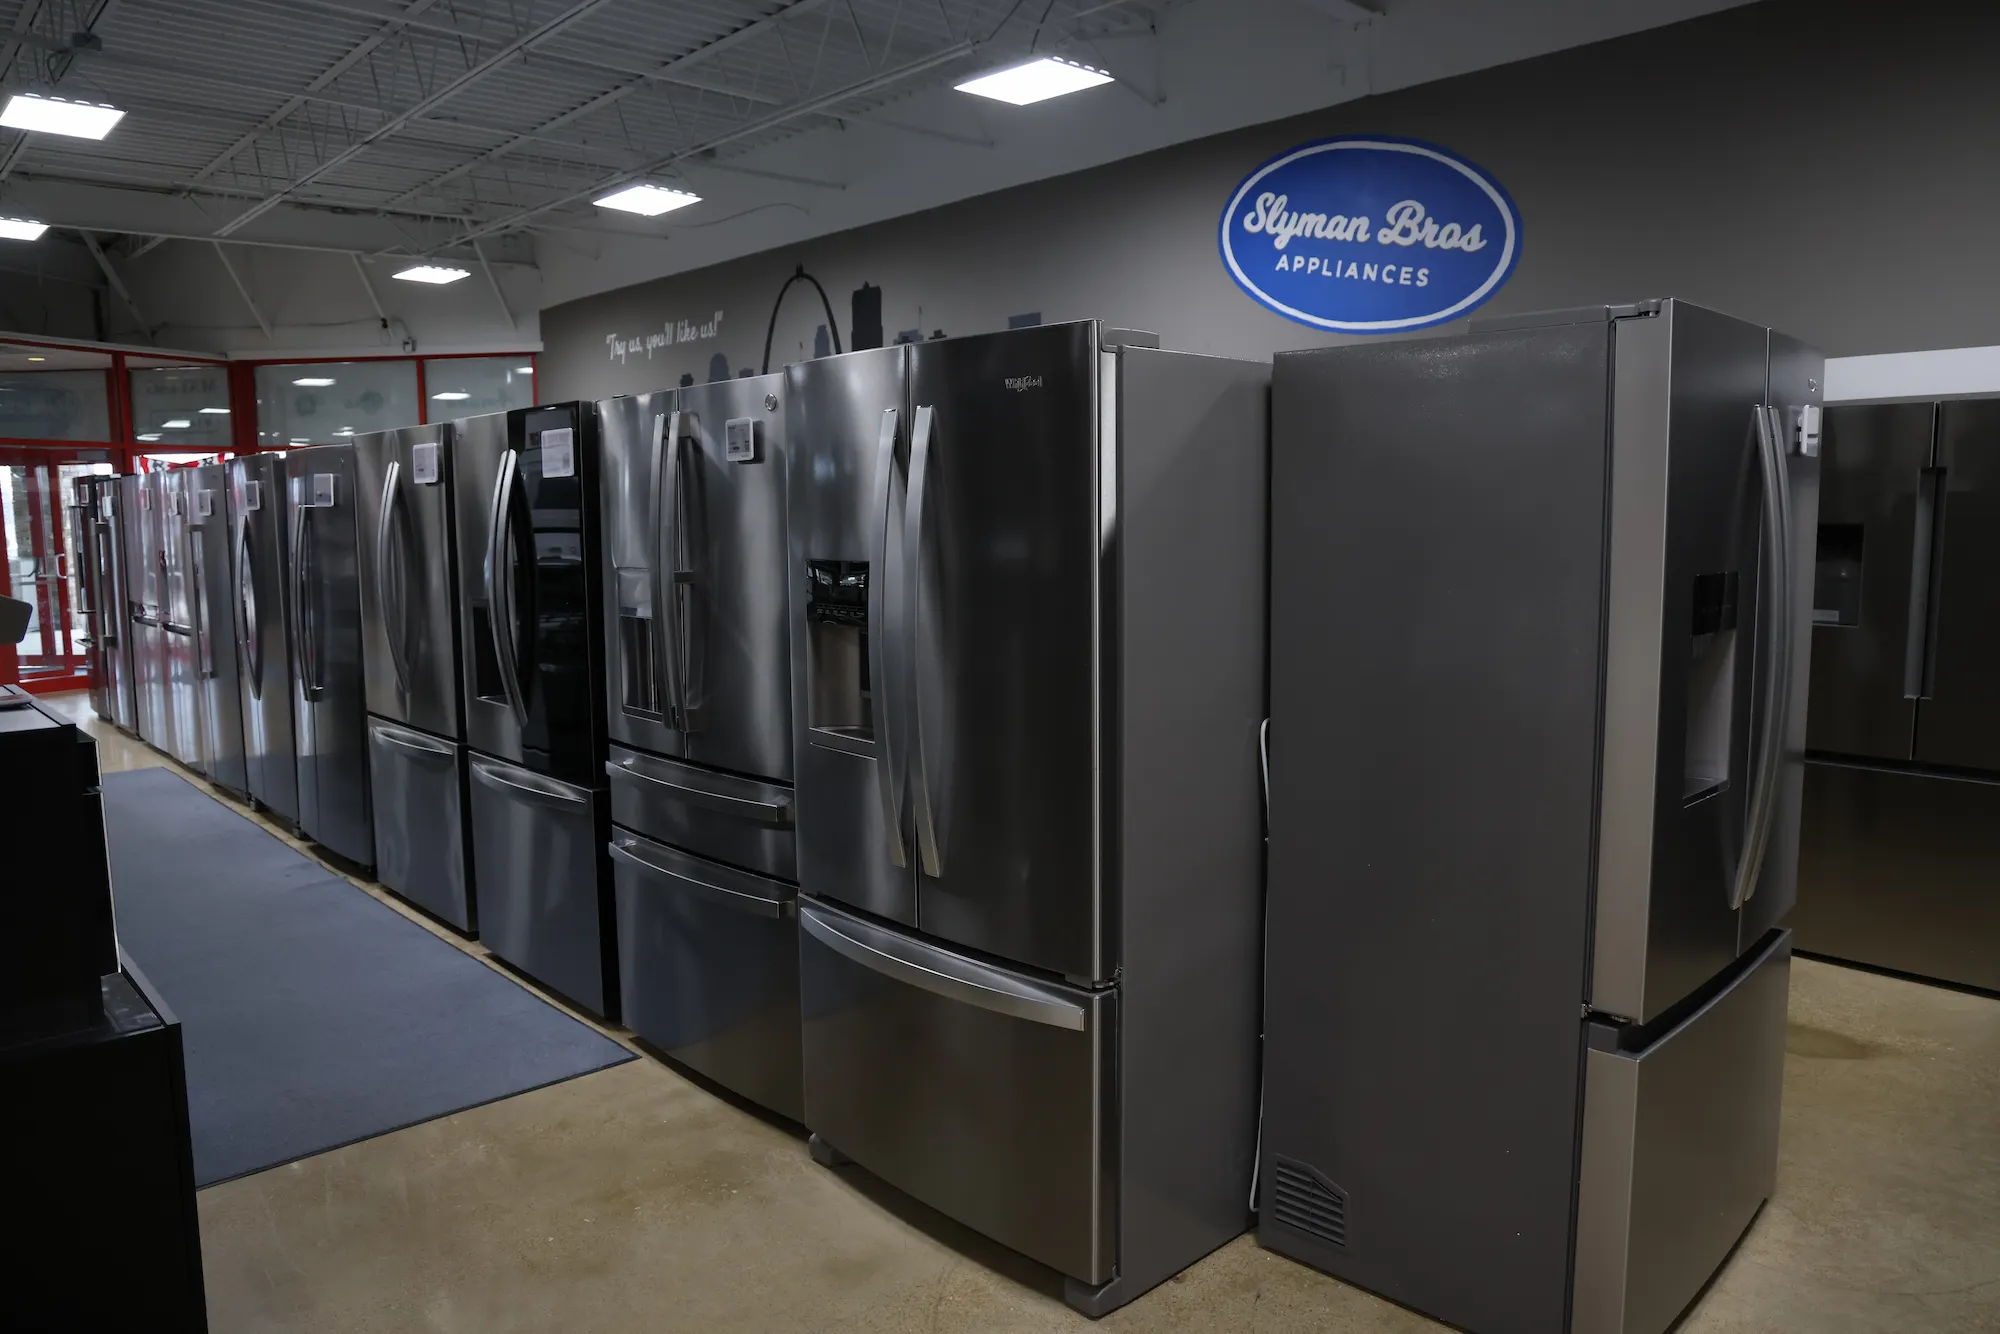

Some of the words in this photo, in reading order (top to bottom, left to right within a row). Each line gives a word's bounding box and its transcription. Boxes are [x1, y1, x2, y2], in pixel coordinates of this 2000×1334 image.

[1243, 191, 1371, 250] Slyman
[1377, 199, 1488, 253] Bros
[1274, 253, 1430, 288] APPLIANCES
[646, 321, 674, 360] you'll
[676, 318, 699, 344] like
